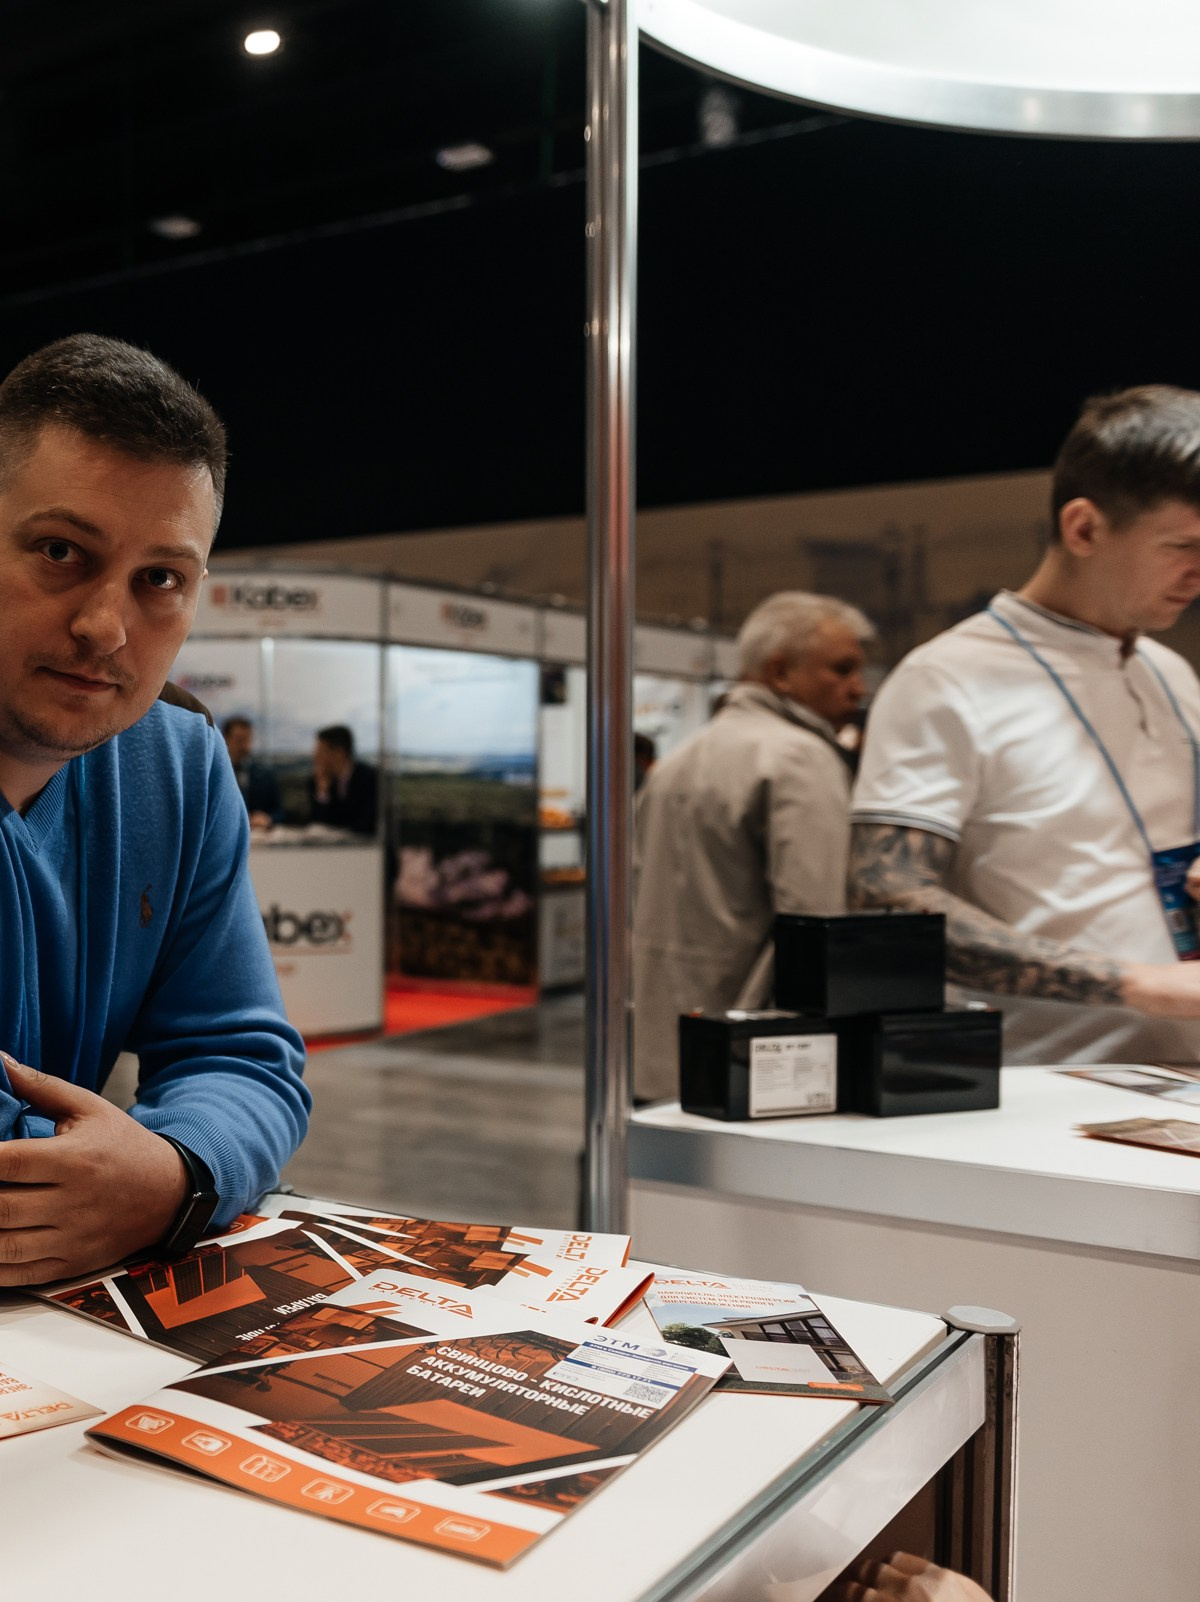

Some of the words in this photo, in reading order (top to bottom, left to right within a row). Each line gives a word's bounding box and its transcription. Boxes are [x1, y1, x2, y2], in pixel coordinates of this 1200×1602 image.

[373, 1281, 473, 1319] DELTA
[547, 1267, 608, 1302] DELTA
[654, 1279, 731, 1290] DELTA
[273, 1292, 328, 1315] БАТАРЕИ
[594, 1335, 640, 1351] ЭТМ
[406, 1366, 486, 1398] БАТАРЕИ
[421, 1356, 590, 1415] АККУМУЛЯТОРНЫЕ
[437, 1346, 528, 1381] СВИНЦОВО
[540, 1379, 653, 1419] КИСЛОТНЫЕ
